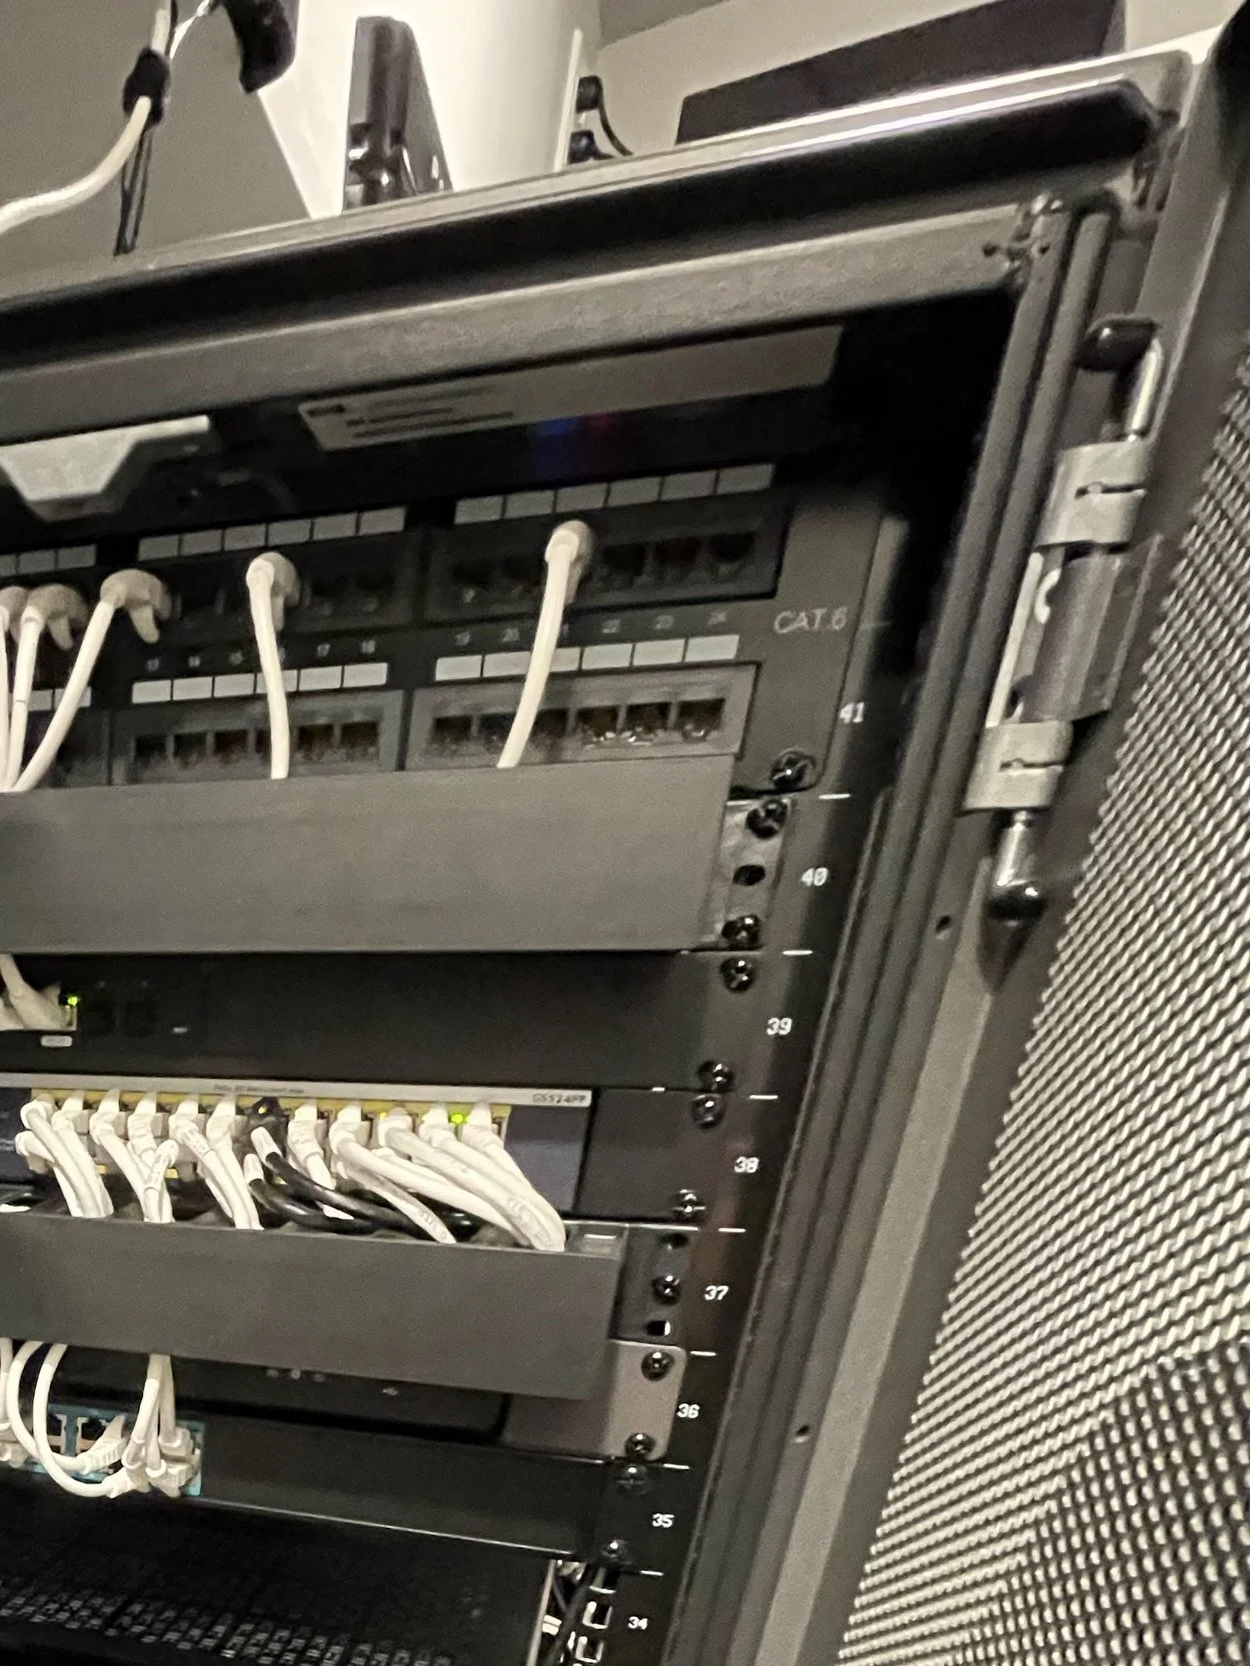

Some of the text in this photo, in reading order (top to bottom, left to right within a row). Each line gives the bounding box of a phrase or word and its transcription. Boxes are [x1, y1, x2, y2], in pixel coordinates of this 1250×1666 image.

[774, 606, 848, 634] CAT.6
[840, 701, 864, 724] 41
[800, 867, 828, 886] 40
[767, 1017, 792, 1036] 39
[734, 1156, 760, 1174] 38
[705, 1286, 730, 1301] 37
[677, 1403, 700, 1418] 36
[652, 1513, 675, 1528] 35
[628, 1616, 648, 1630] 34
